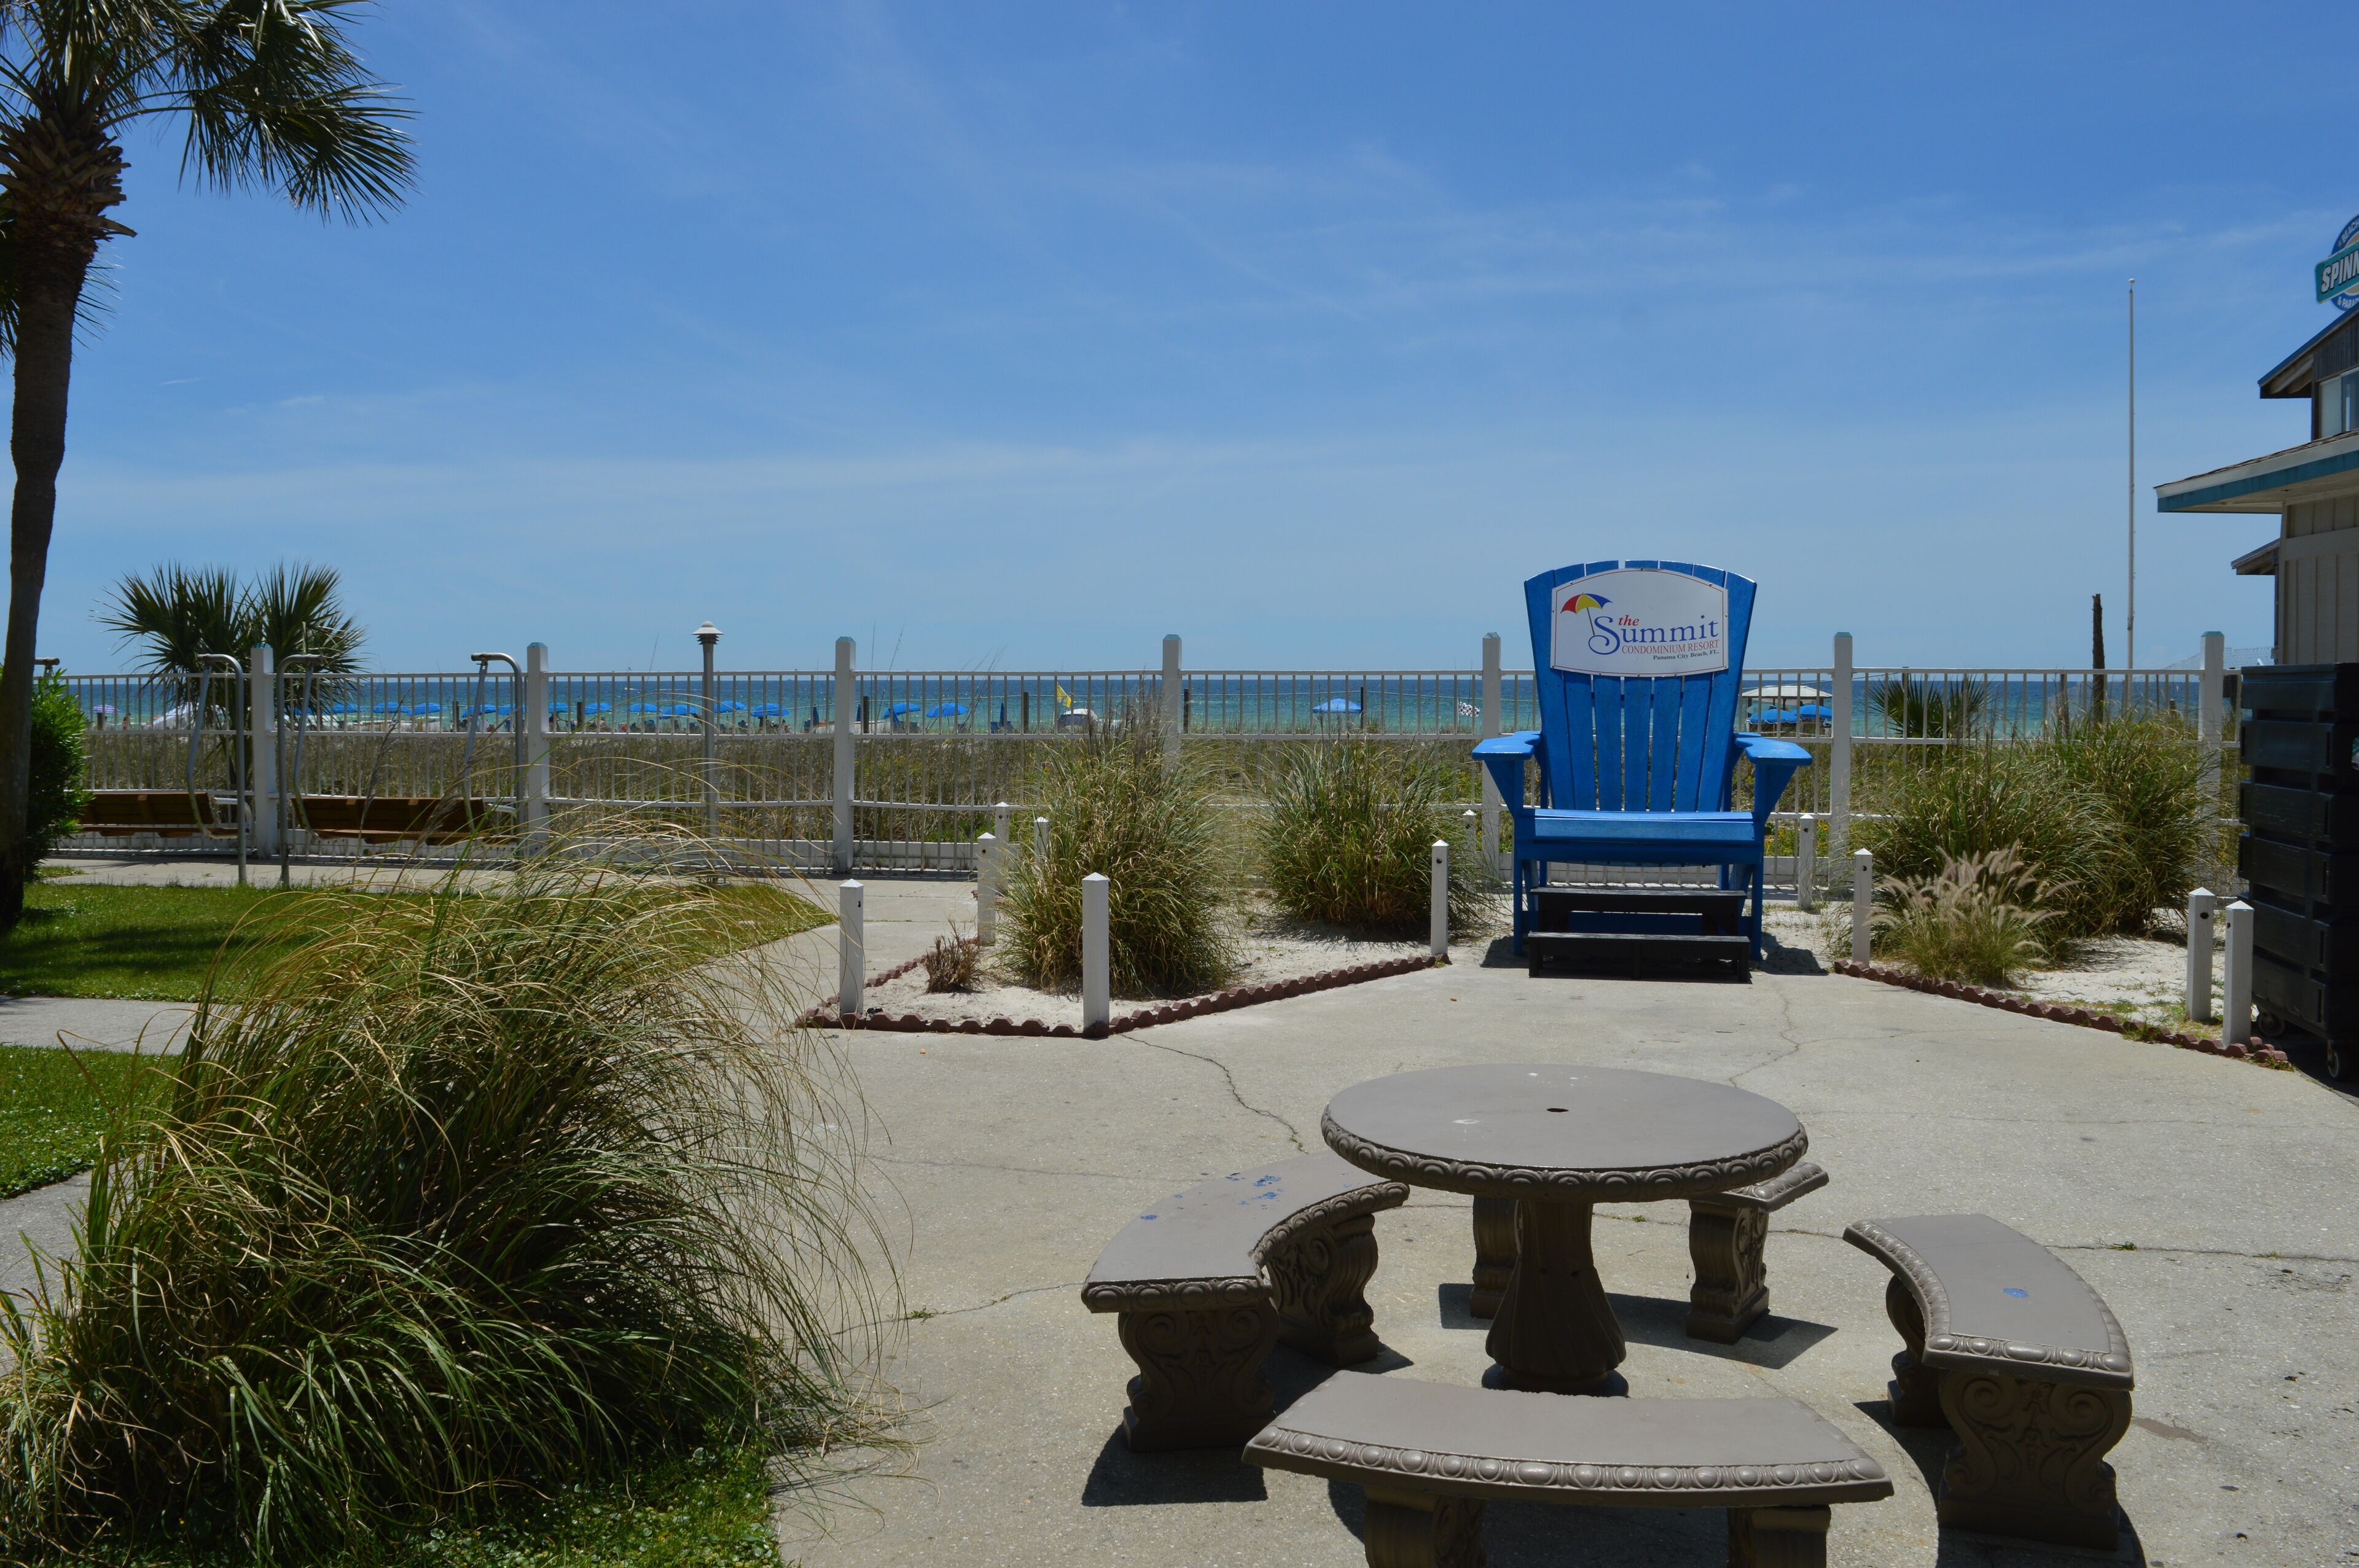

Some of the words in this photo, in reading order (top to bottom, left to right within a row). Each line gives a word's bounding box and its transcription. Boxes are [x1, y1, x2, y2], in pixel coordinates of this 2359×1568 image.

[2337, 296, 2342, 305] &
[1618, 615, 1640, 626] the
[1588, 615, 1719, 655] Summit
[1622, 644, 1685, 654] CONDOMINIUM
[1688, 639, 1719, 652] RESORT
